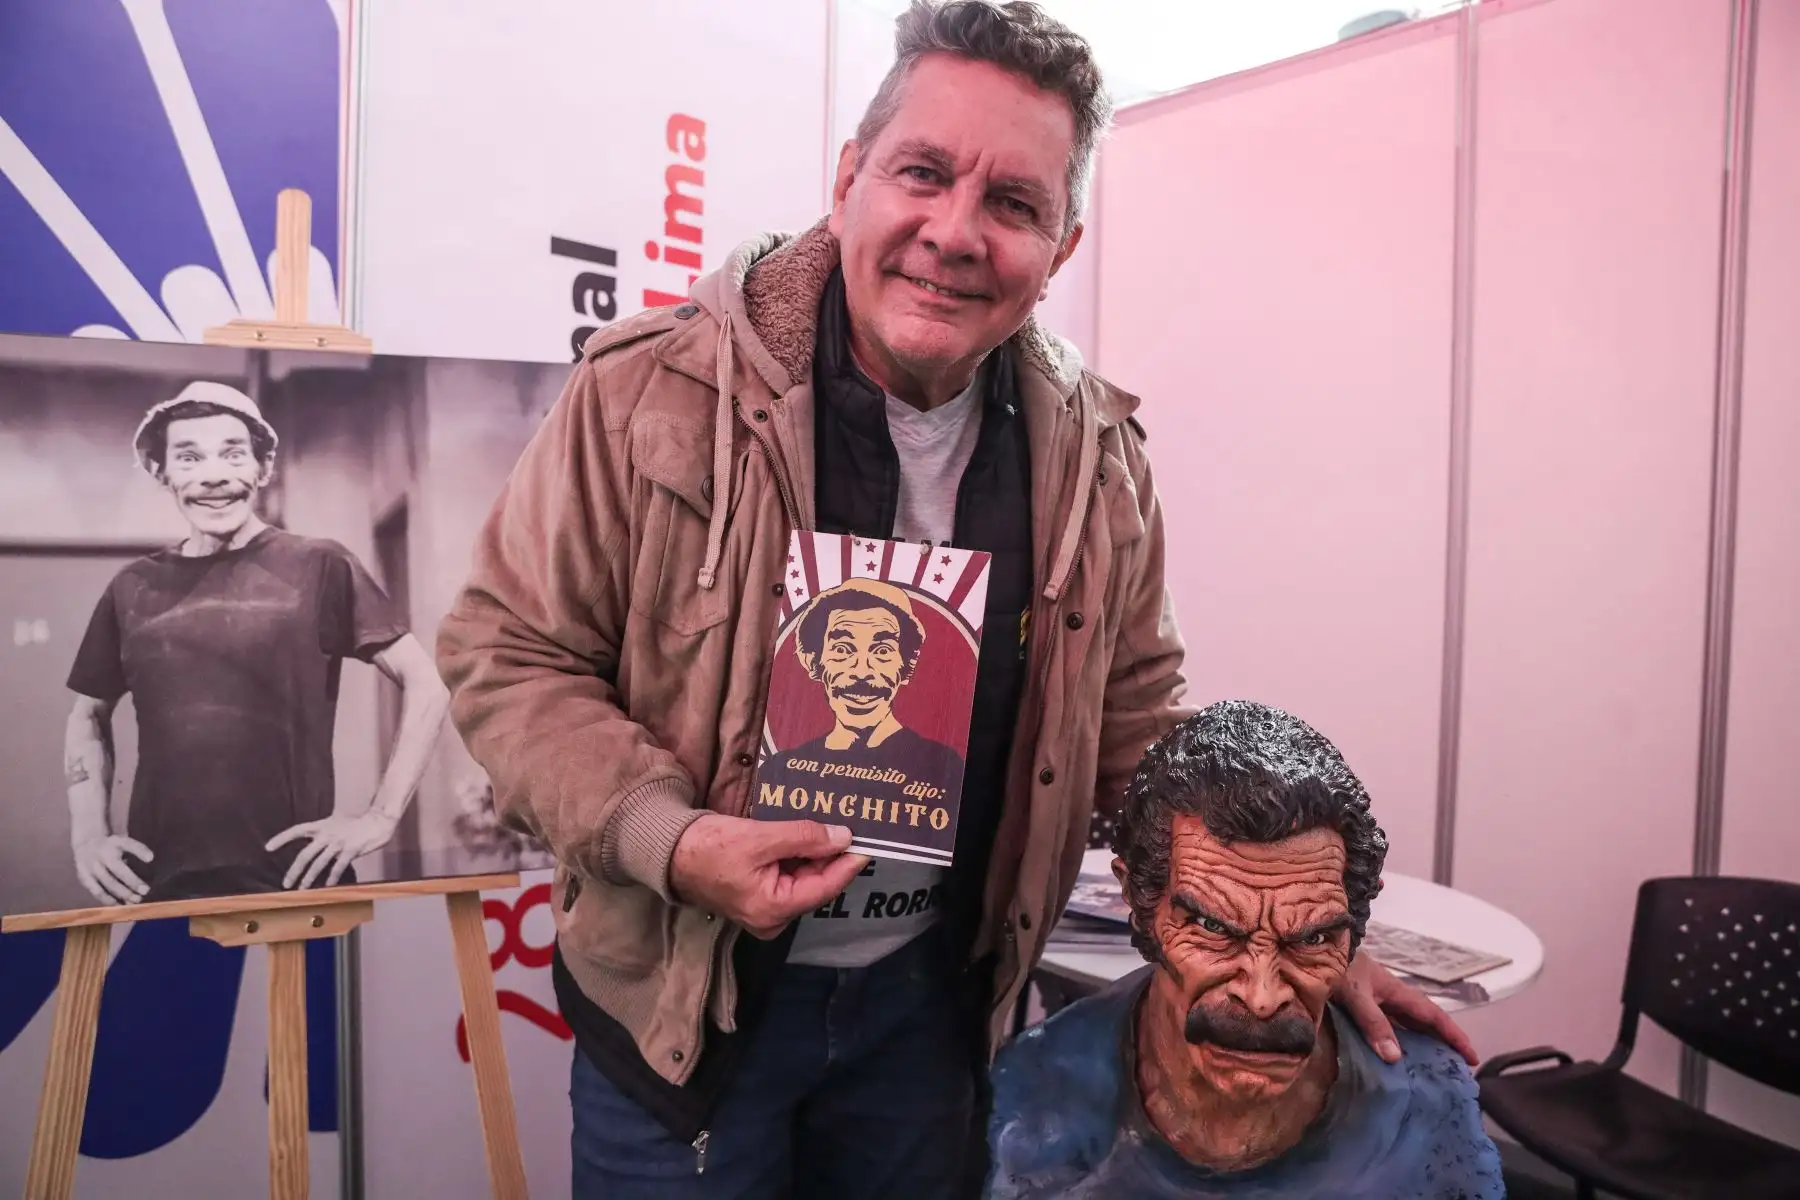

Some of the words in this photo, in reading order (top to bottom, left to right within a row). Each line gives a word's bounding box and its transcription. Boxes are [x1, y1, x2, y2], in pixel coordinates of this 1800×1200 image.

[786, 757, 819, 773] con
[821, 762, 907, 785] permisito
[903, 780, 947, 801] dijo:
[758, 782, 950, 831] MONCHITO
